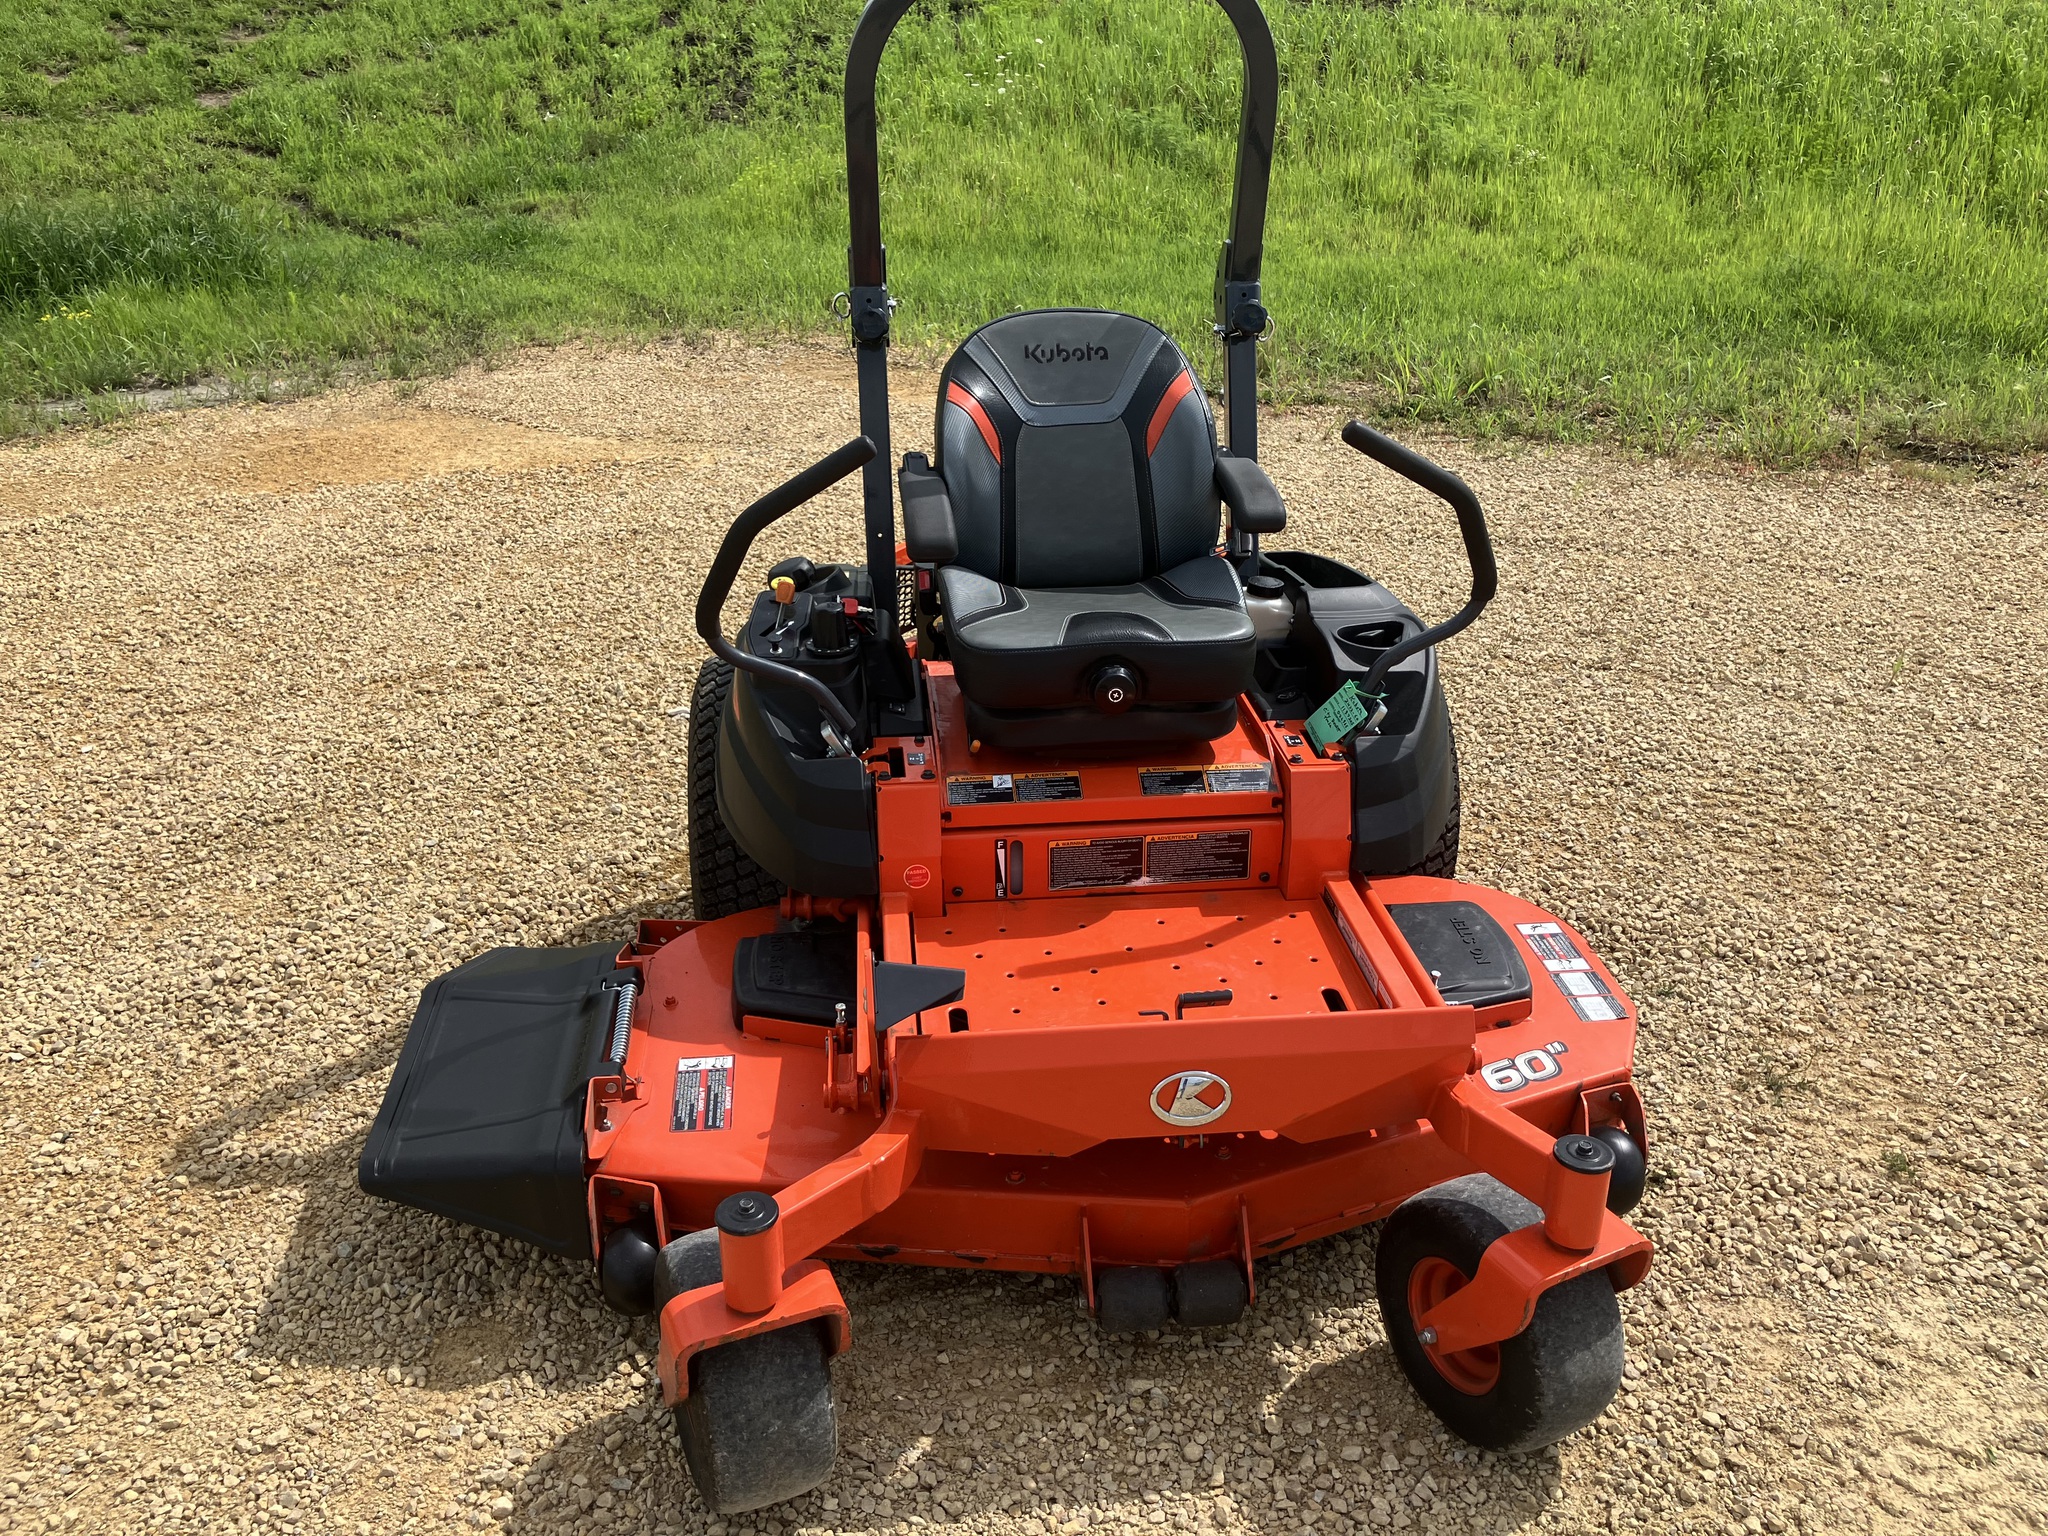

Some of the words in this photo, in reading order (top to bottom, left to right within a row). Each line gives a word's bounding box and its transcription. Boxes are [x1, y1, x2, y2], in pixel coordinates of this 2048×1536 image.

[1024, 342, 1109, 364] Kubota
[997, 889, 1004, 897] E
[1480, 1040, 1568, 1093] 60"
